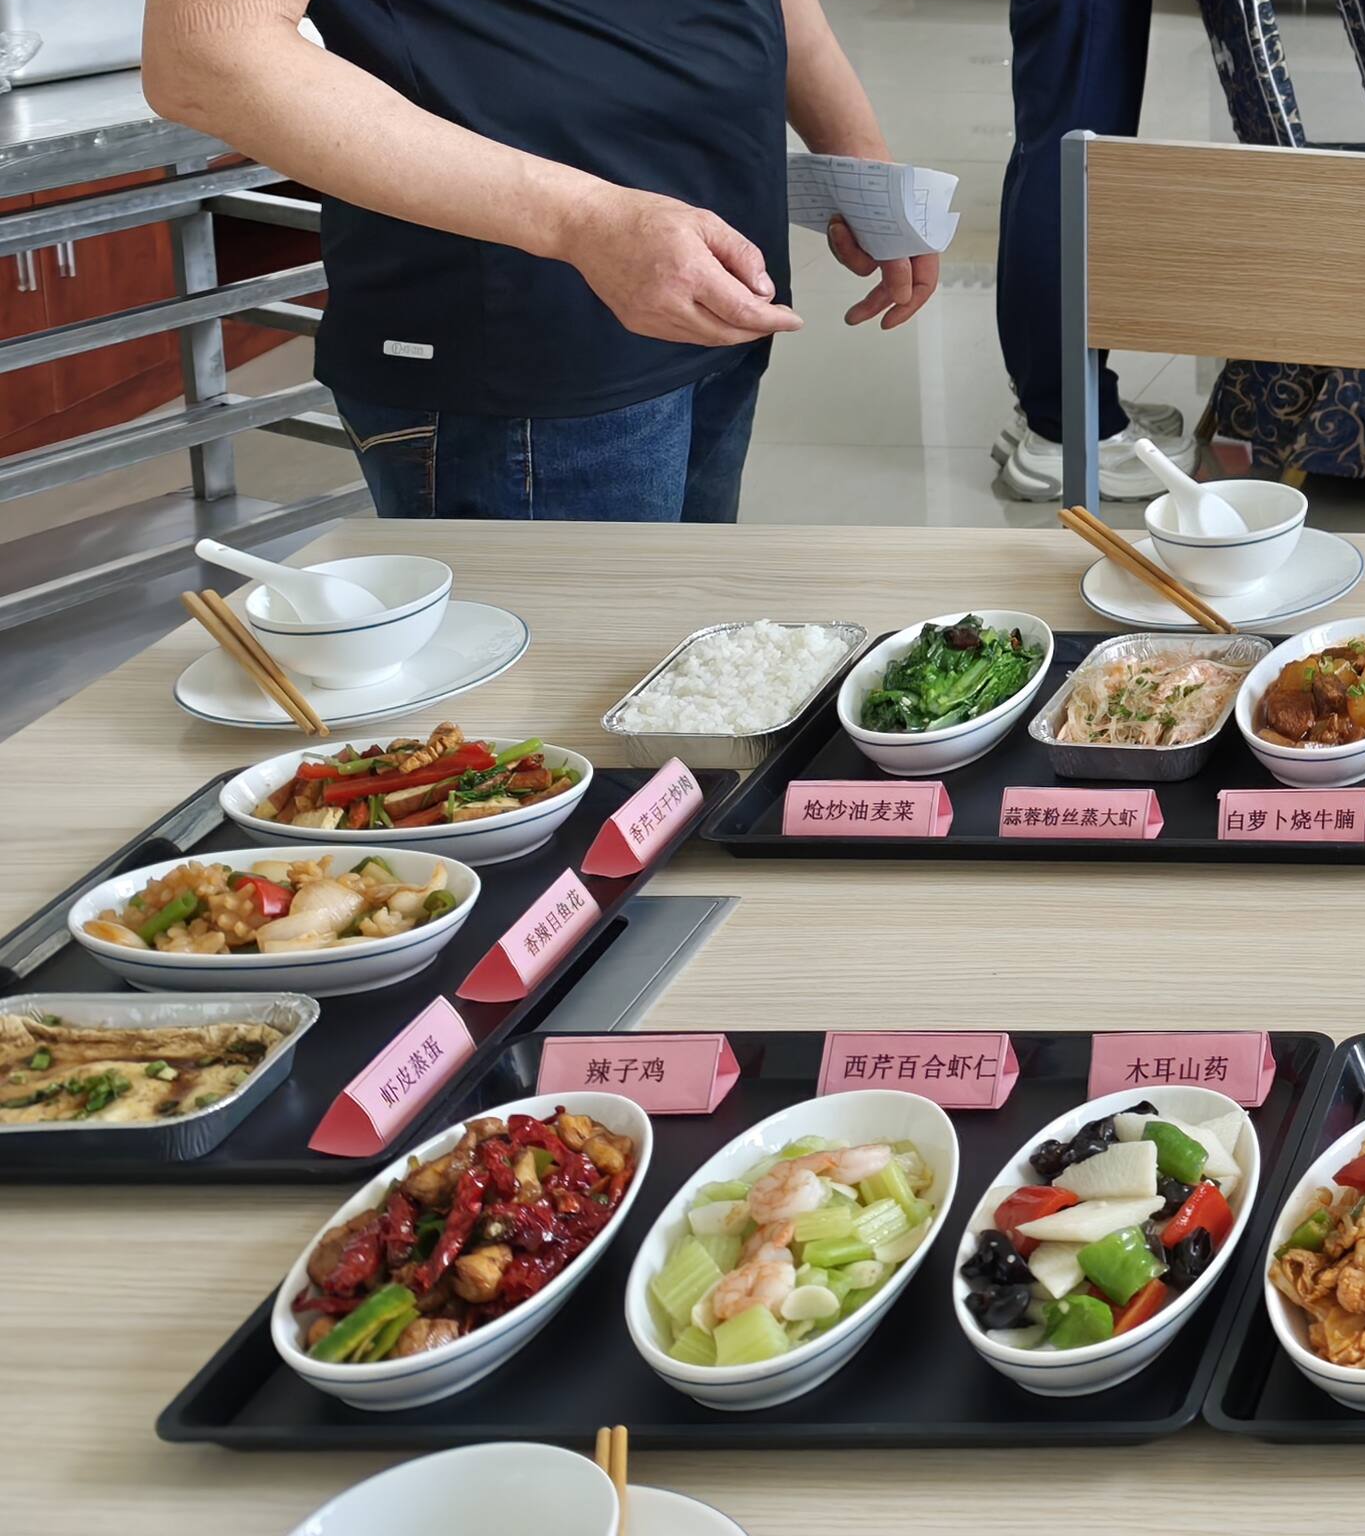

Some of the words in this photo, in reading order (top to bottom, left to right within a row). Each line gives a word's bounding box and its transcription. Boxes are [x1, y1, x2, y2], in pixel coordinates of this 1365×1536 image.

[628, 774, 694, 845] 香芹豆干炒肉
[802, 799, 915, 822] 炝炒油麦菜
[1003, 807, 1138, 827] 蒜蓉粉丝蒸大虾
[1227, 808, 1356, 832] 白萝卜烧牛腩
[378, 1034, 444, 1109] 虾皮蒸蛋
[584, 1056, 664, 1085] 辣子鸡
[844, 1054, 998, 1080] 西芹百合虾仁
[1124, 1056, 1229, 1083] 木耳山药
